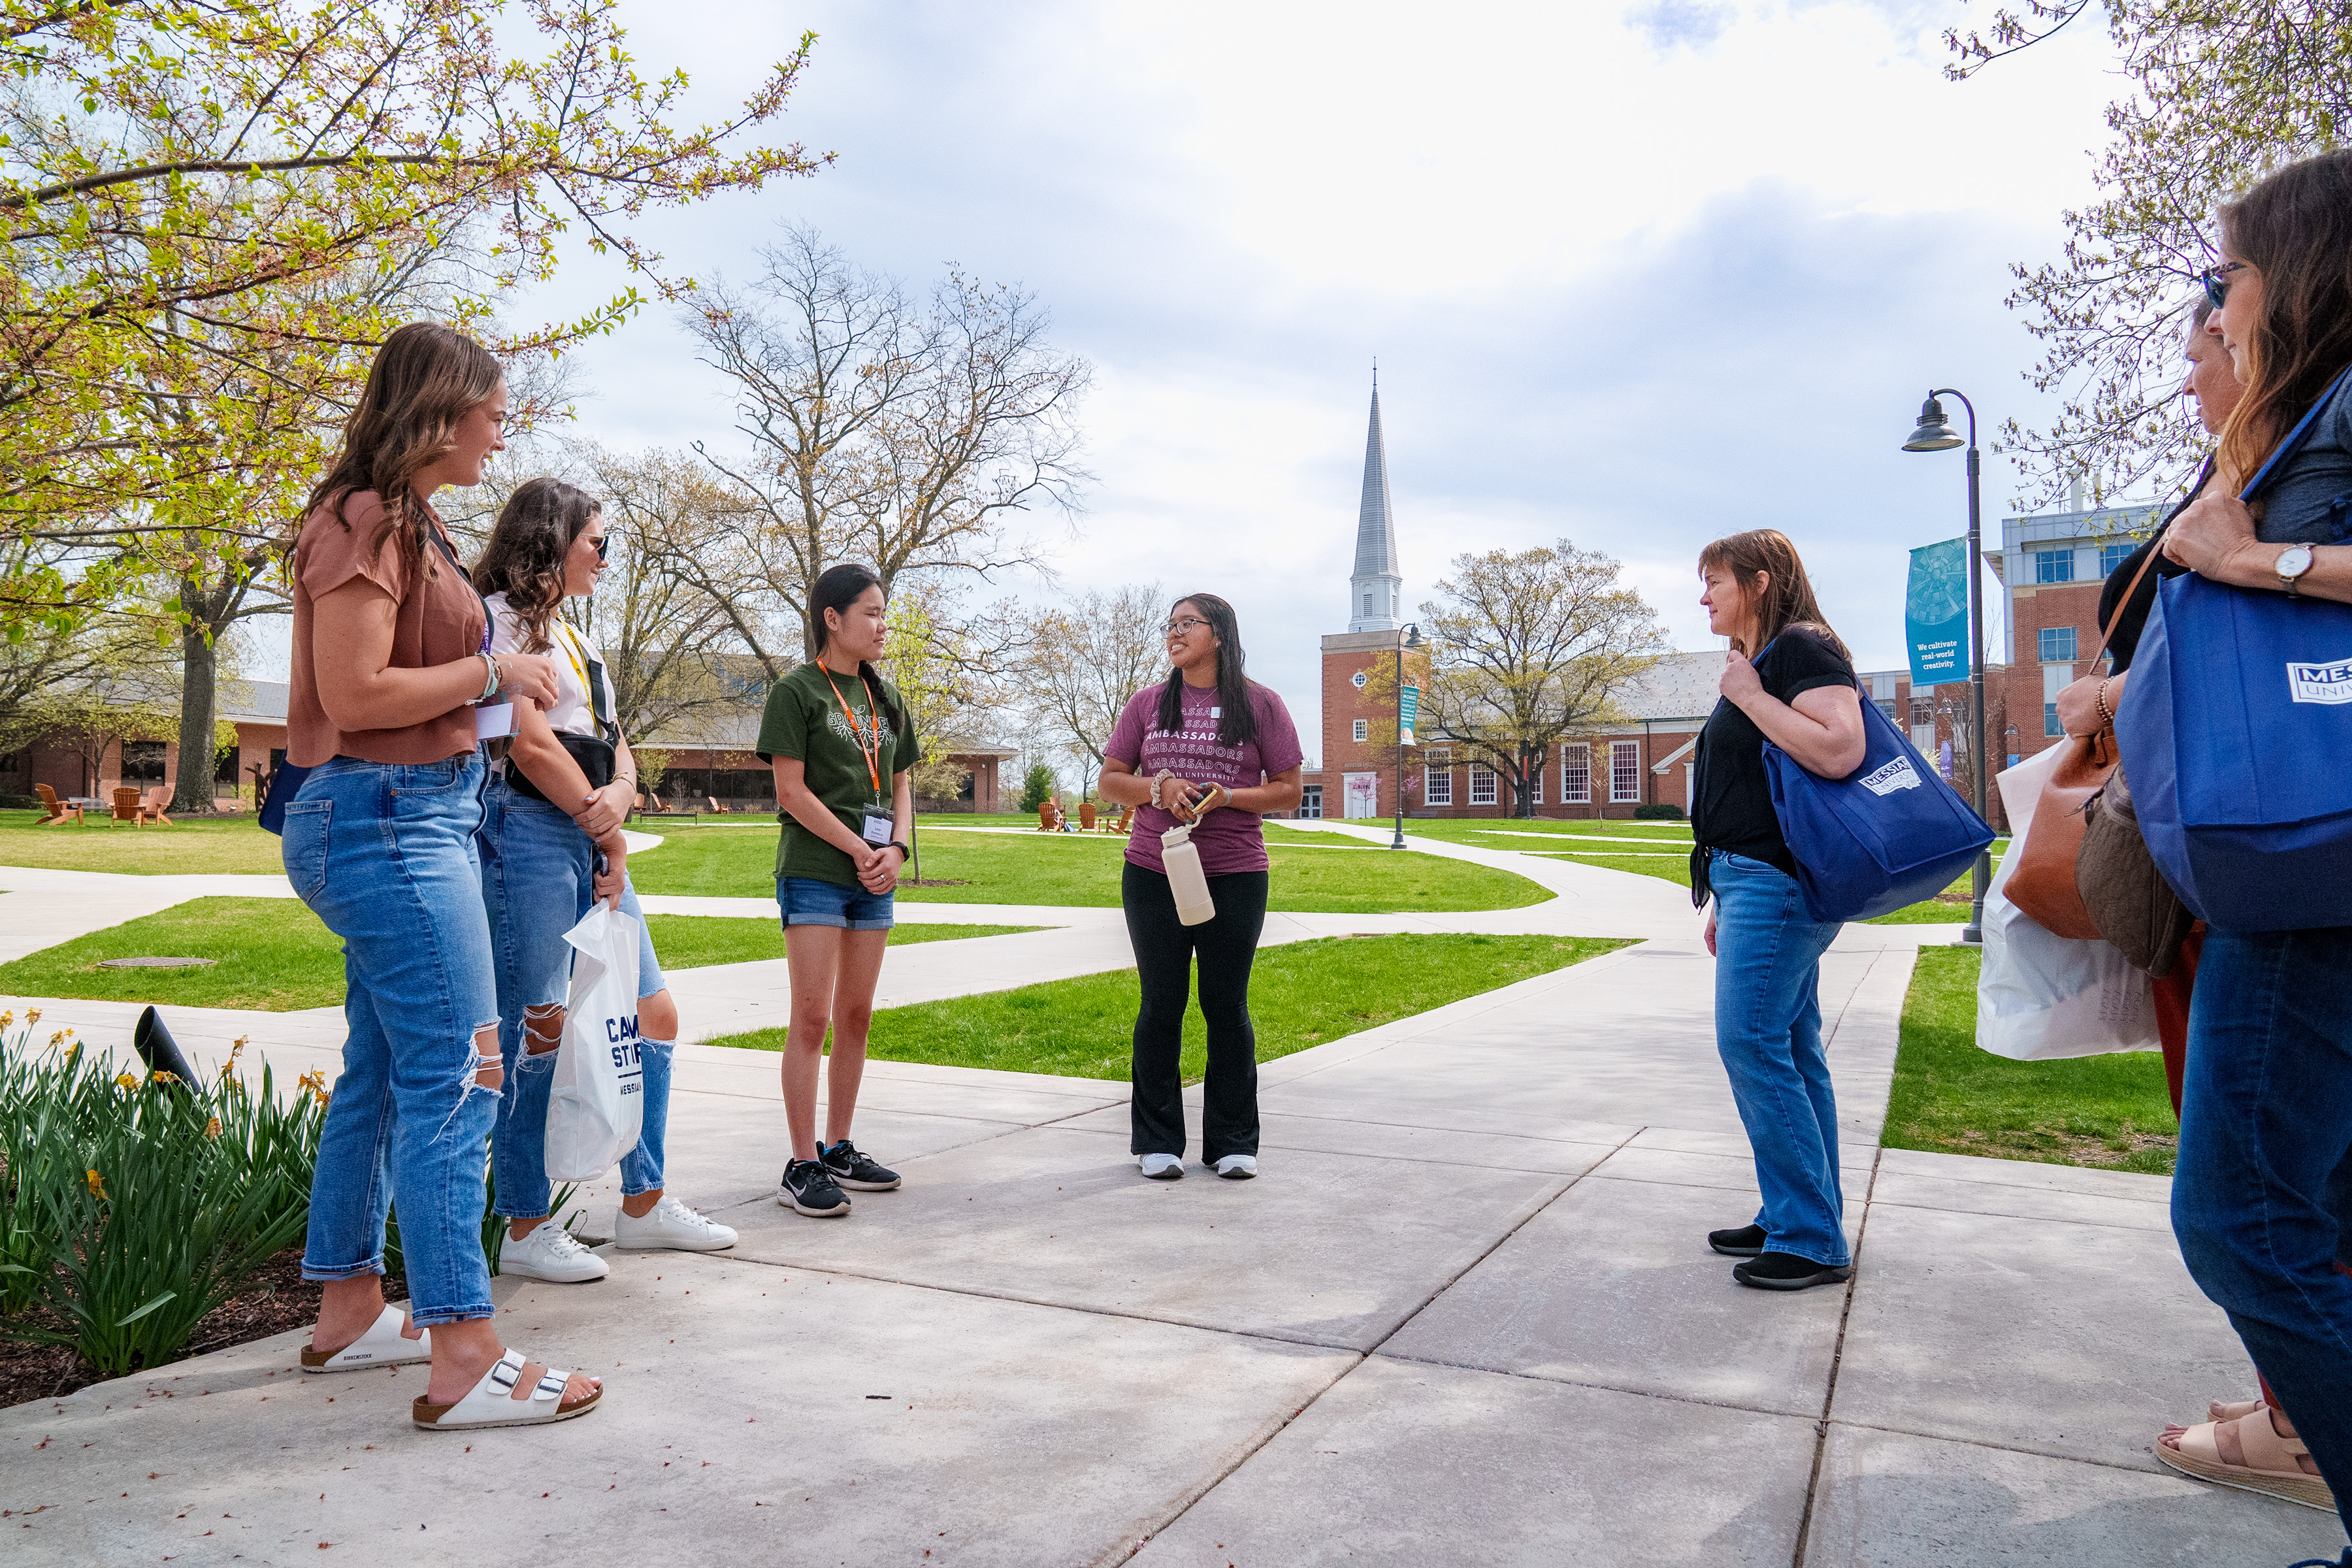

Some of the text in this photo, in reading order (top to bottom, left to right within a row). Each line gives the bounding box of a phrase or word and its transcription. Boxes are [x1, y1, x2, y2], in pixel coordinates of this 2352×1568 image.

[1928, 641, 1957, 649] cultivate
[1921, 649, 1955, 661] real-world
[1923, 661, 1955, 670] creativity.
[1146, 729, 1243, 746] AMBASSAD
[1145, 742, 1243, 761] AMBASSADORS
[1148, 758, 1240, 774] AMBASSADORS
[1867, 760, 1910, 785] MESSIAH
[1185, 772, 1235, 782] UNIVERSITY
[1876, 771, 1915, 790] UNIVERSITY
[612, 1042, 641, 1068] STR
